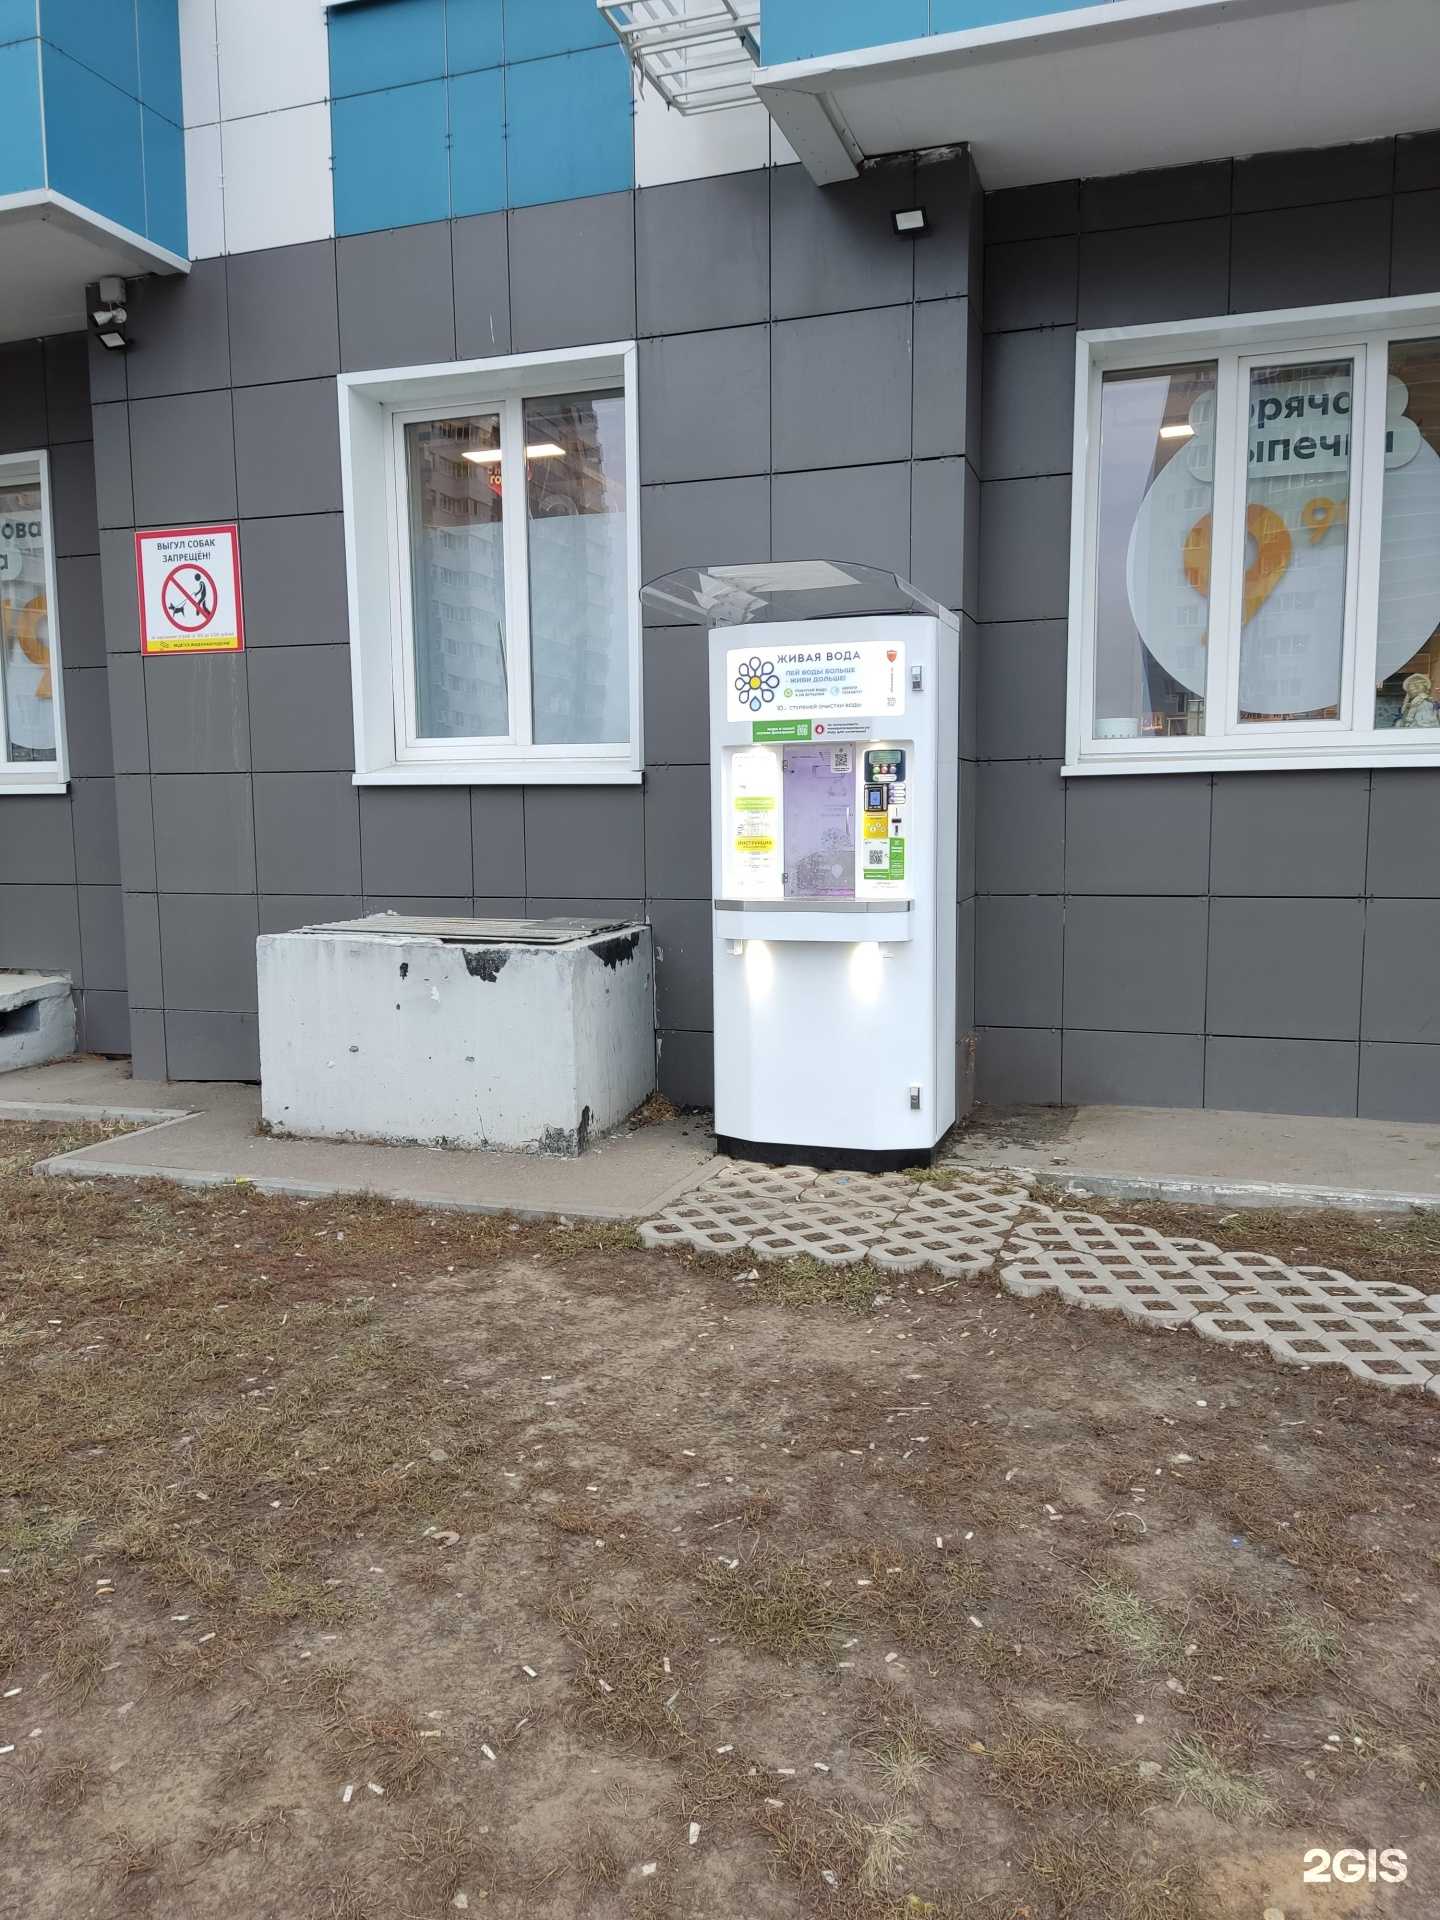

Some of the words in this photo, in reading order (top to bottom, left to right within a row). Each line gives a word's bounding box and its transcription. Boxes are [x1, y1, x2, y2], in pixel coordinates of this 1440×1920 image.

[157, 540, 186, 551] ВЫГУЛ
[187, 538, 216, 549] СОБАК
[777, 653, 822, 664] ЖИВАЯ
[826, 650, 862, 662] ВОДА
